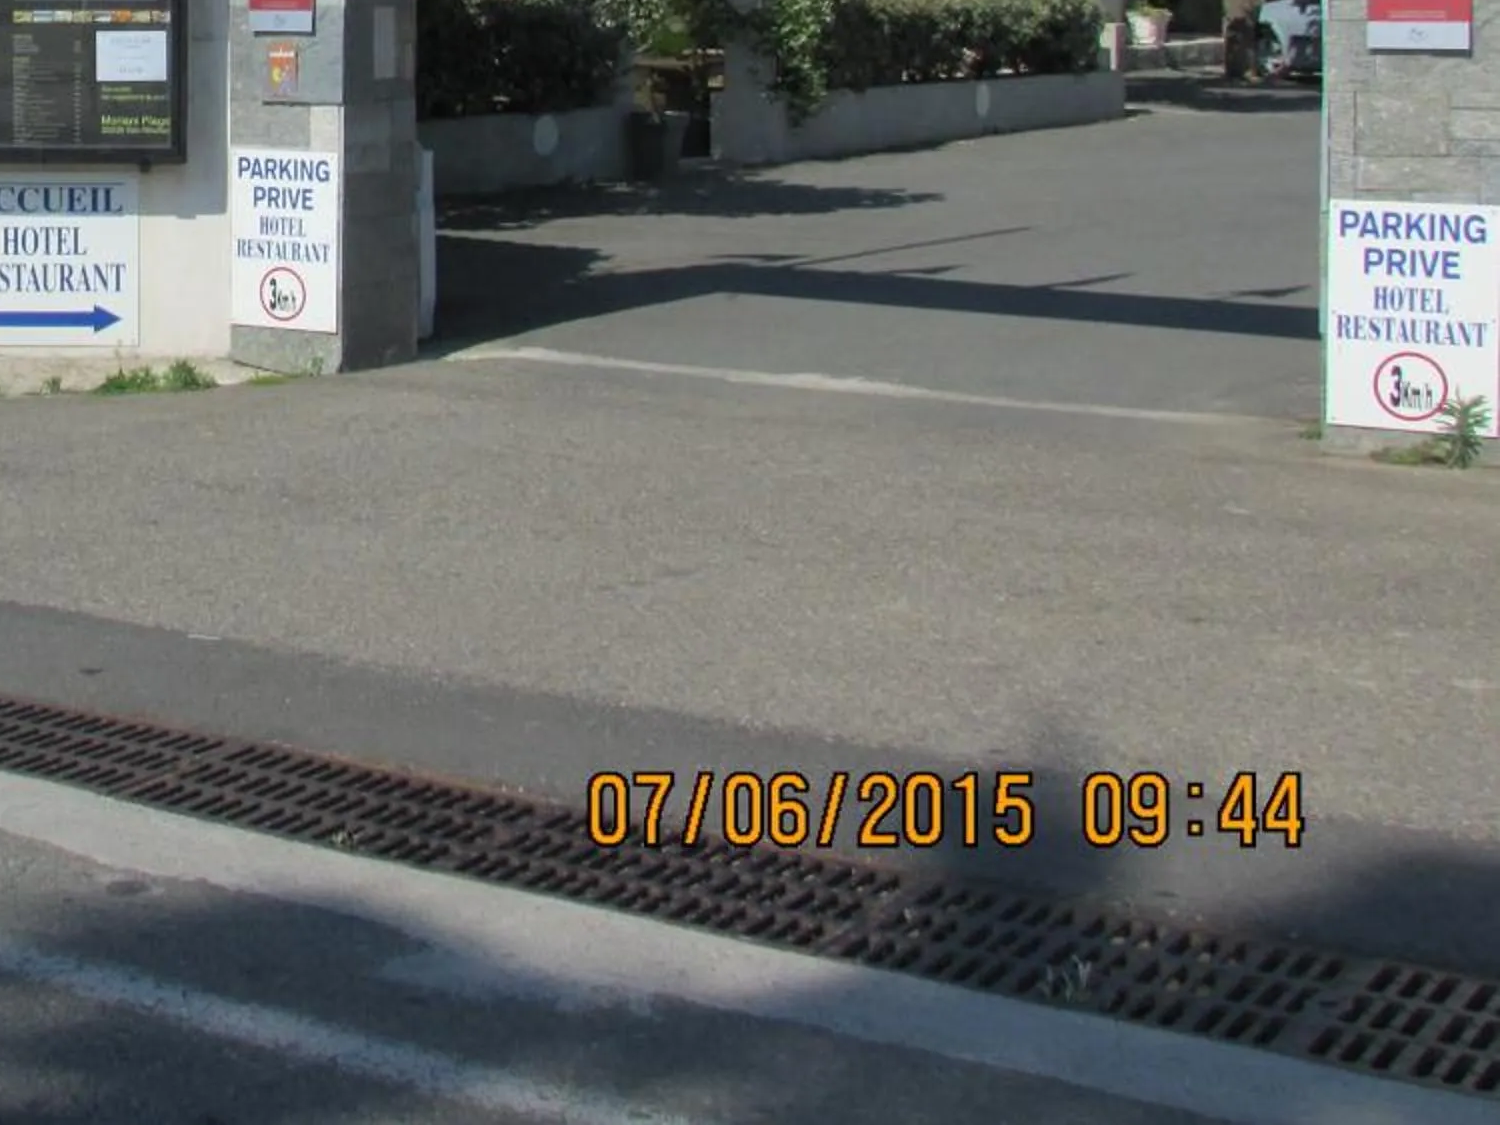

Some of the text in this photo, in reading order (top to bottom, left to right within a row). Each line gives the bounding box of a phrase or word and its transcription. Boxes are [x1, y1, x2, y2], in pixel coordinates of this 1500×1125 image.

[238, 157, 330, 183] PARKING
[253, 186, 315, 211] PRIVE
[2, 226, 88, 256] HOTEL
[259, 215, 307, 238] HOTEL
[1339, 210, 1487, 244] PARKING
[237, 239, 330, 263] RESTAURANT
[1363, 247, 1461, 280] PRIVE
[1373, 286, 1450, 315] HOTEL
[1336, 314, 1488, 348] RESTAURANT
